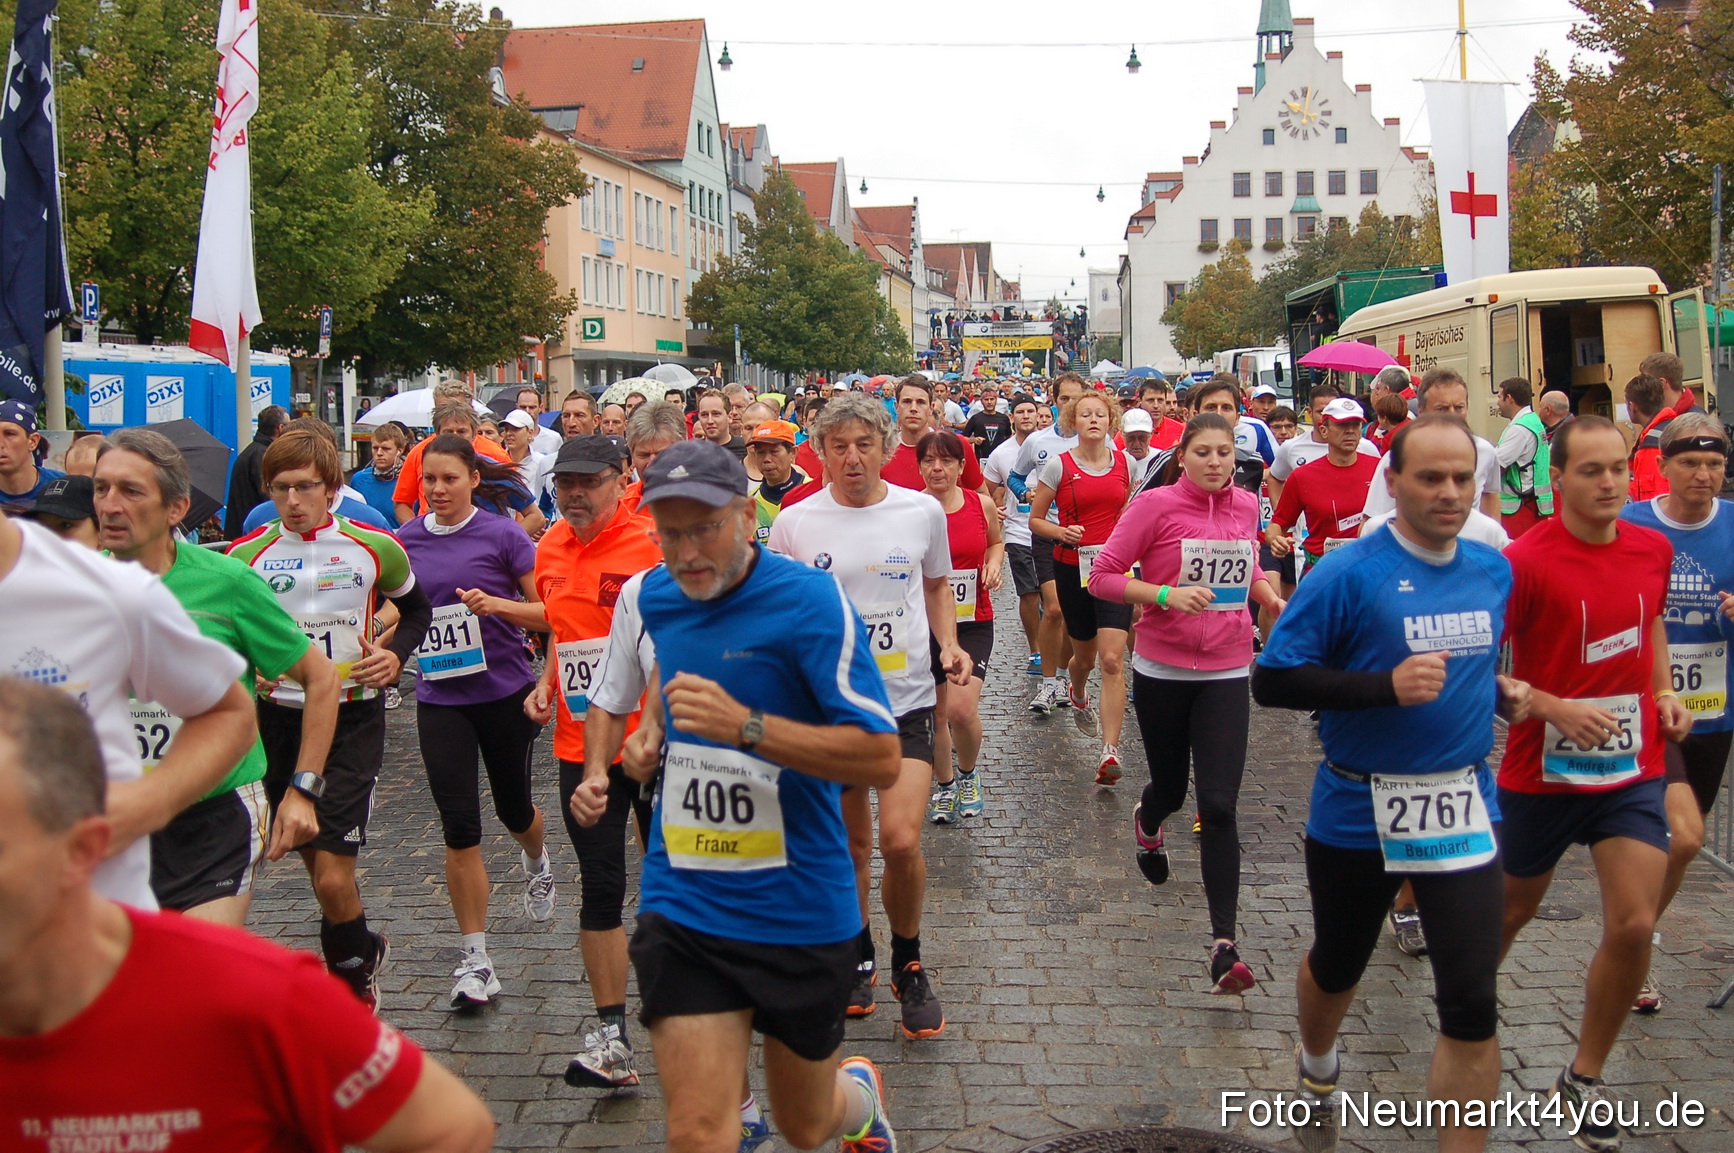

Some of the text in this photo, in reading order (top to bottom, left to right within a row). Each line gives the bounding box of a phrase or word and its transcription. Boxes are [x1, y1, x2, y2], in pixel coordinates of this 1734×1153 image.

[85, 288, 96, 317] P
[323, 312, 330, 333] P
[585, 320, 602, 338] D
[991, 340, 1023, 348] START
[1415, 324, 1464, 352] Bayerisches
[1414, 354, 1438, 373] Rotes
[1187, 558, 1247, 583] 3123
[304, 619, 345, 628] Neumarkt
[1403, 610, 1493, 640] HUBER
[1427, 634, 1490, 649] TECHNOLOGY
[1602, 637, 1625, 653] DEHN
[558, 647, 604, 659] PARTL Neuma
[1672, 652, 1712, 660] Neumarkt
[431, 657, 463, 670] Andrea
[668, 755, 697, 770] PARTL
[1567, 759, 1617, 773] Andreas
[682, 778, 755, 825] 406
[1386, 790, 1473, 834] 2767
[695, 833, 739, 854] Franz
[1404, 838, 1470, 858] Bernhard
[52, 1108, 201, 1137] NEUMARKTER
[48, 1133, 172, 1153] STADTLAUF
